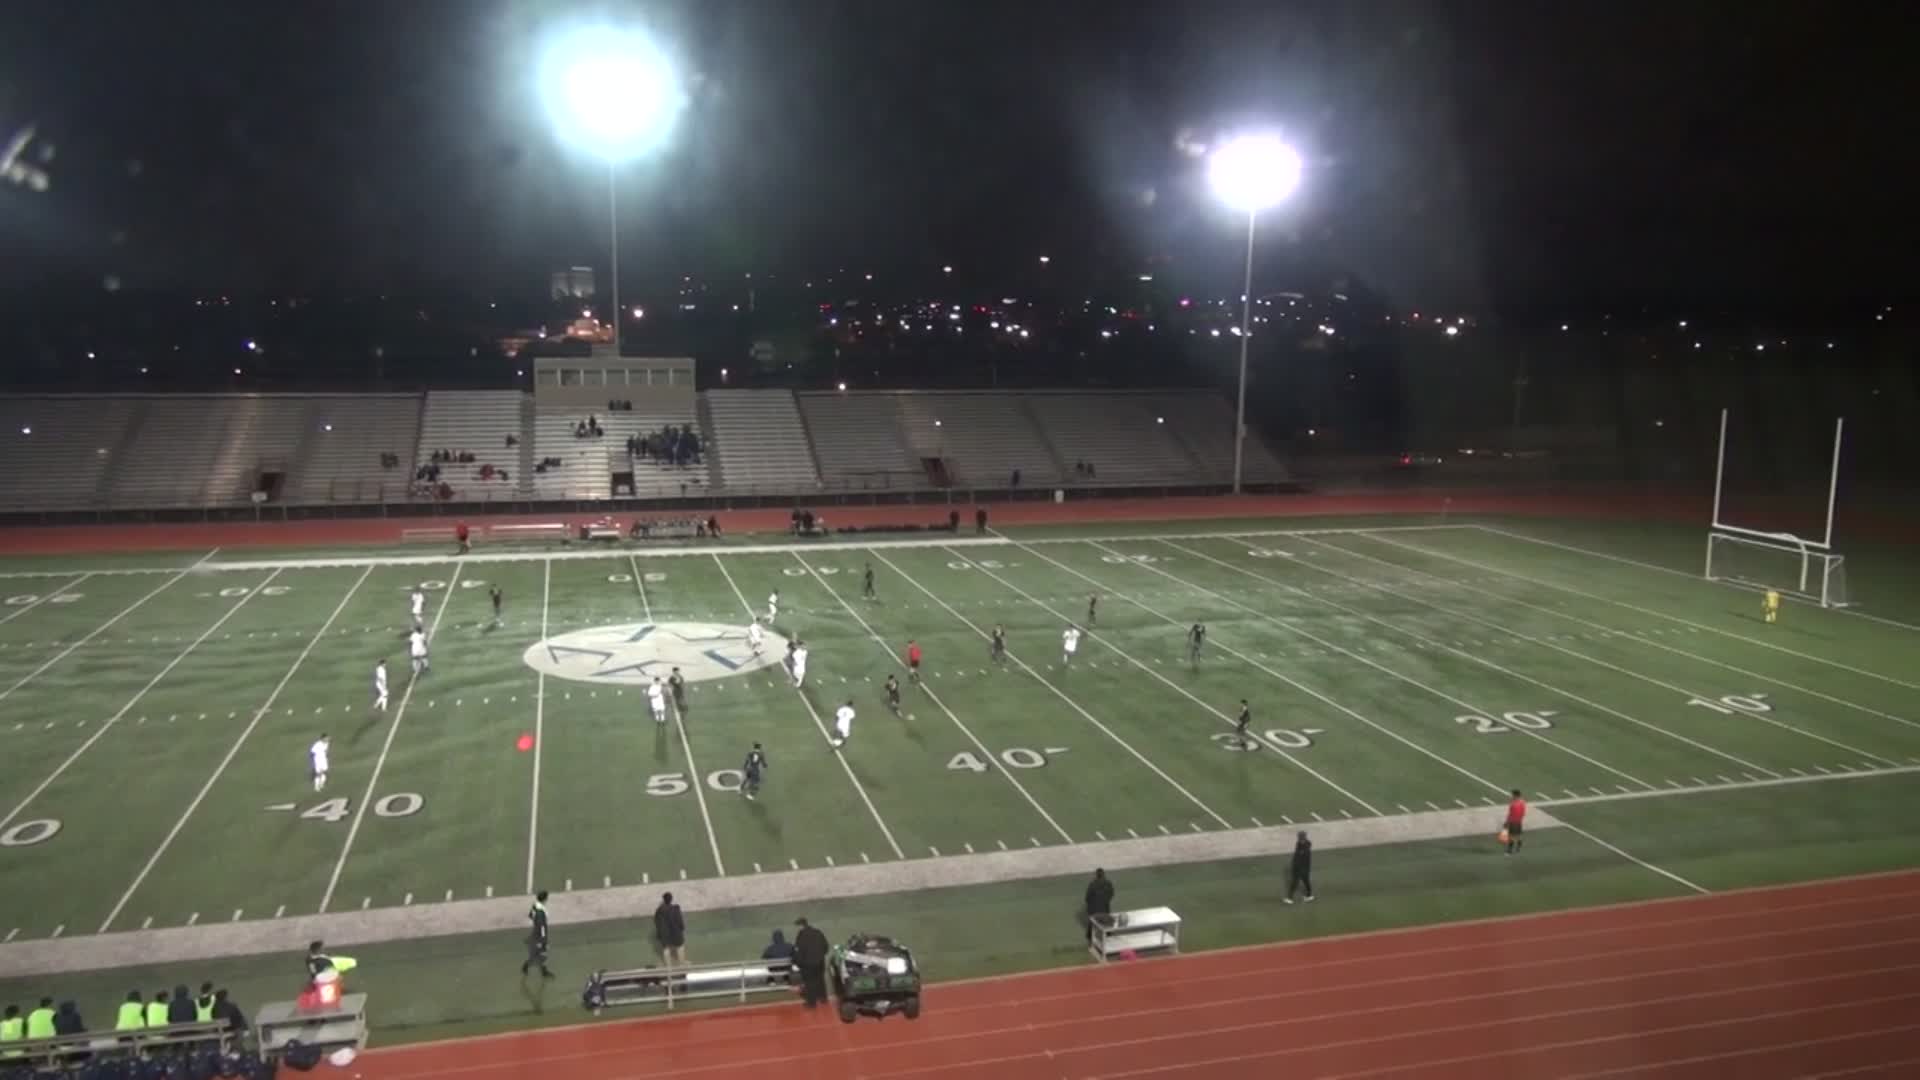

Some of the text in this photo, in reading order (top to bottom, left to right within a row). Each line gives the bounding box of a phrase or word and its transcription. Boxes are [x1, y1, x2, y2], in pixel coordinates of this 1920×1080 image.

[1686, 695, 1772, 714] 10
[1454, 711, 1552, 733] 20
[1210, 729, 1312, 752] 30
[946, 747, 1048, 773] 40
[645, 768, 747, 796] 50
[301, 792, 424, 822] 40
